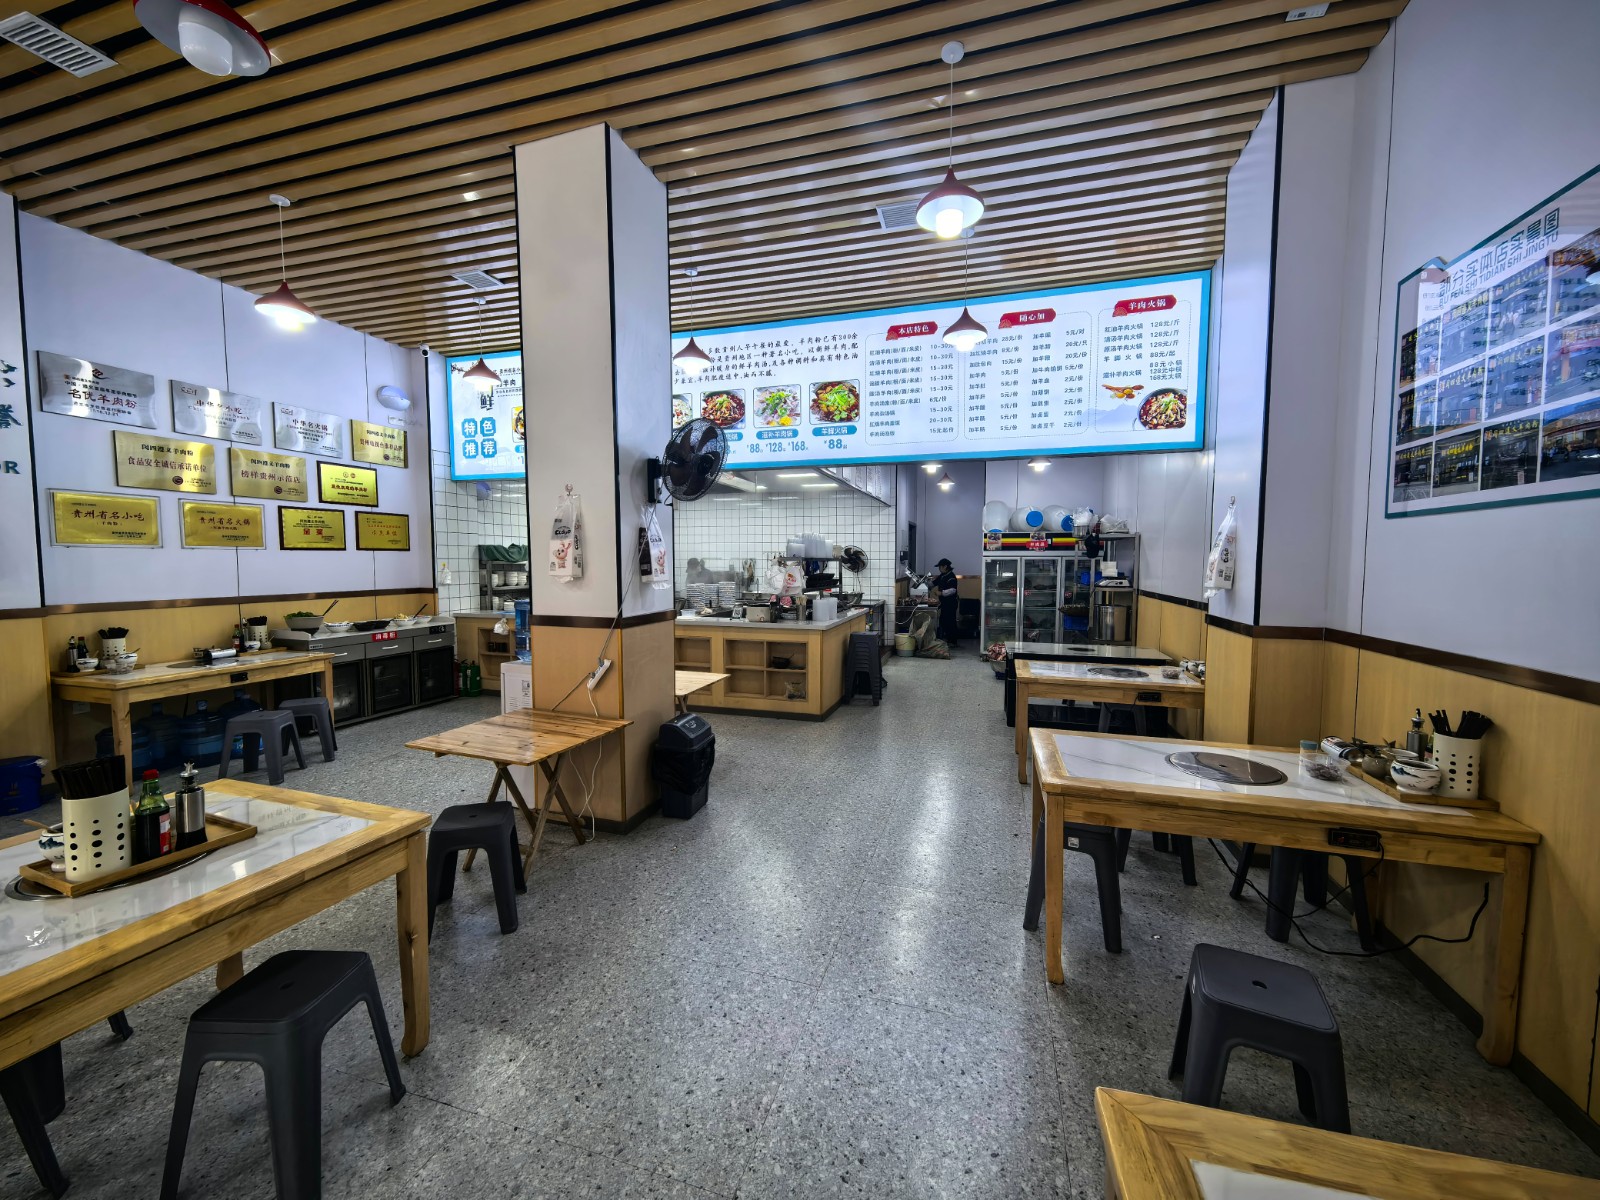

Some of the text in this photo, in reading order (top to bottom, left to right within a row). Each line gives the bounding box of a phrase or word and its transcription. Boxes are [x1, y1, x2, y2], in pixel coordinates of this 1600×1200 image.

[1440, 207, 1560, 297] 部分实体店实景图
[1128, 298, 1166, 310] 羊肉火锅
[898, 325, 930, 335] 本店特色
[1104, 319, 1180, 333] 红油羊肉火锅 128元/斤
[1104, 329, 1180, 343] 清汤羊肉火锅 128元/斤
[67, 388, 137, 409] 名优羊肉粉
[292, 419, 328, 432] 中华名火锅
[464, 421, 495, 437] 特色
[465, 441, 496, 456] 推荐
[128, 456, 207, 473] 食品安全诚信承诺单位
[241, 469, 301, 484] 榜样贵州示范店
[71, 508, 145, 522] 贵州省名小吃
[199, 516, 251, 526] 贵州省名火锅
